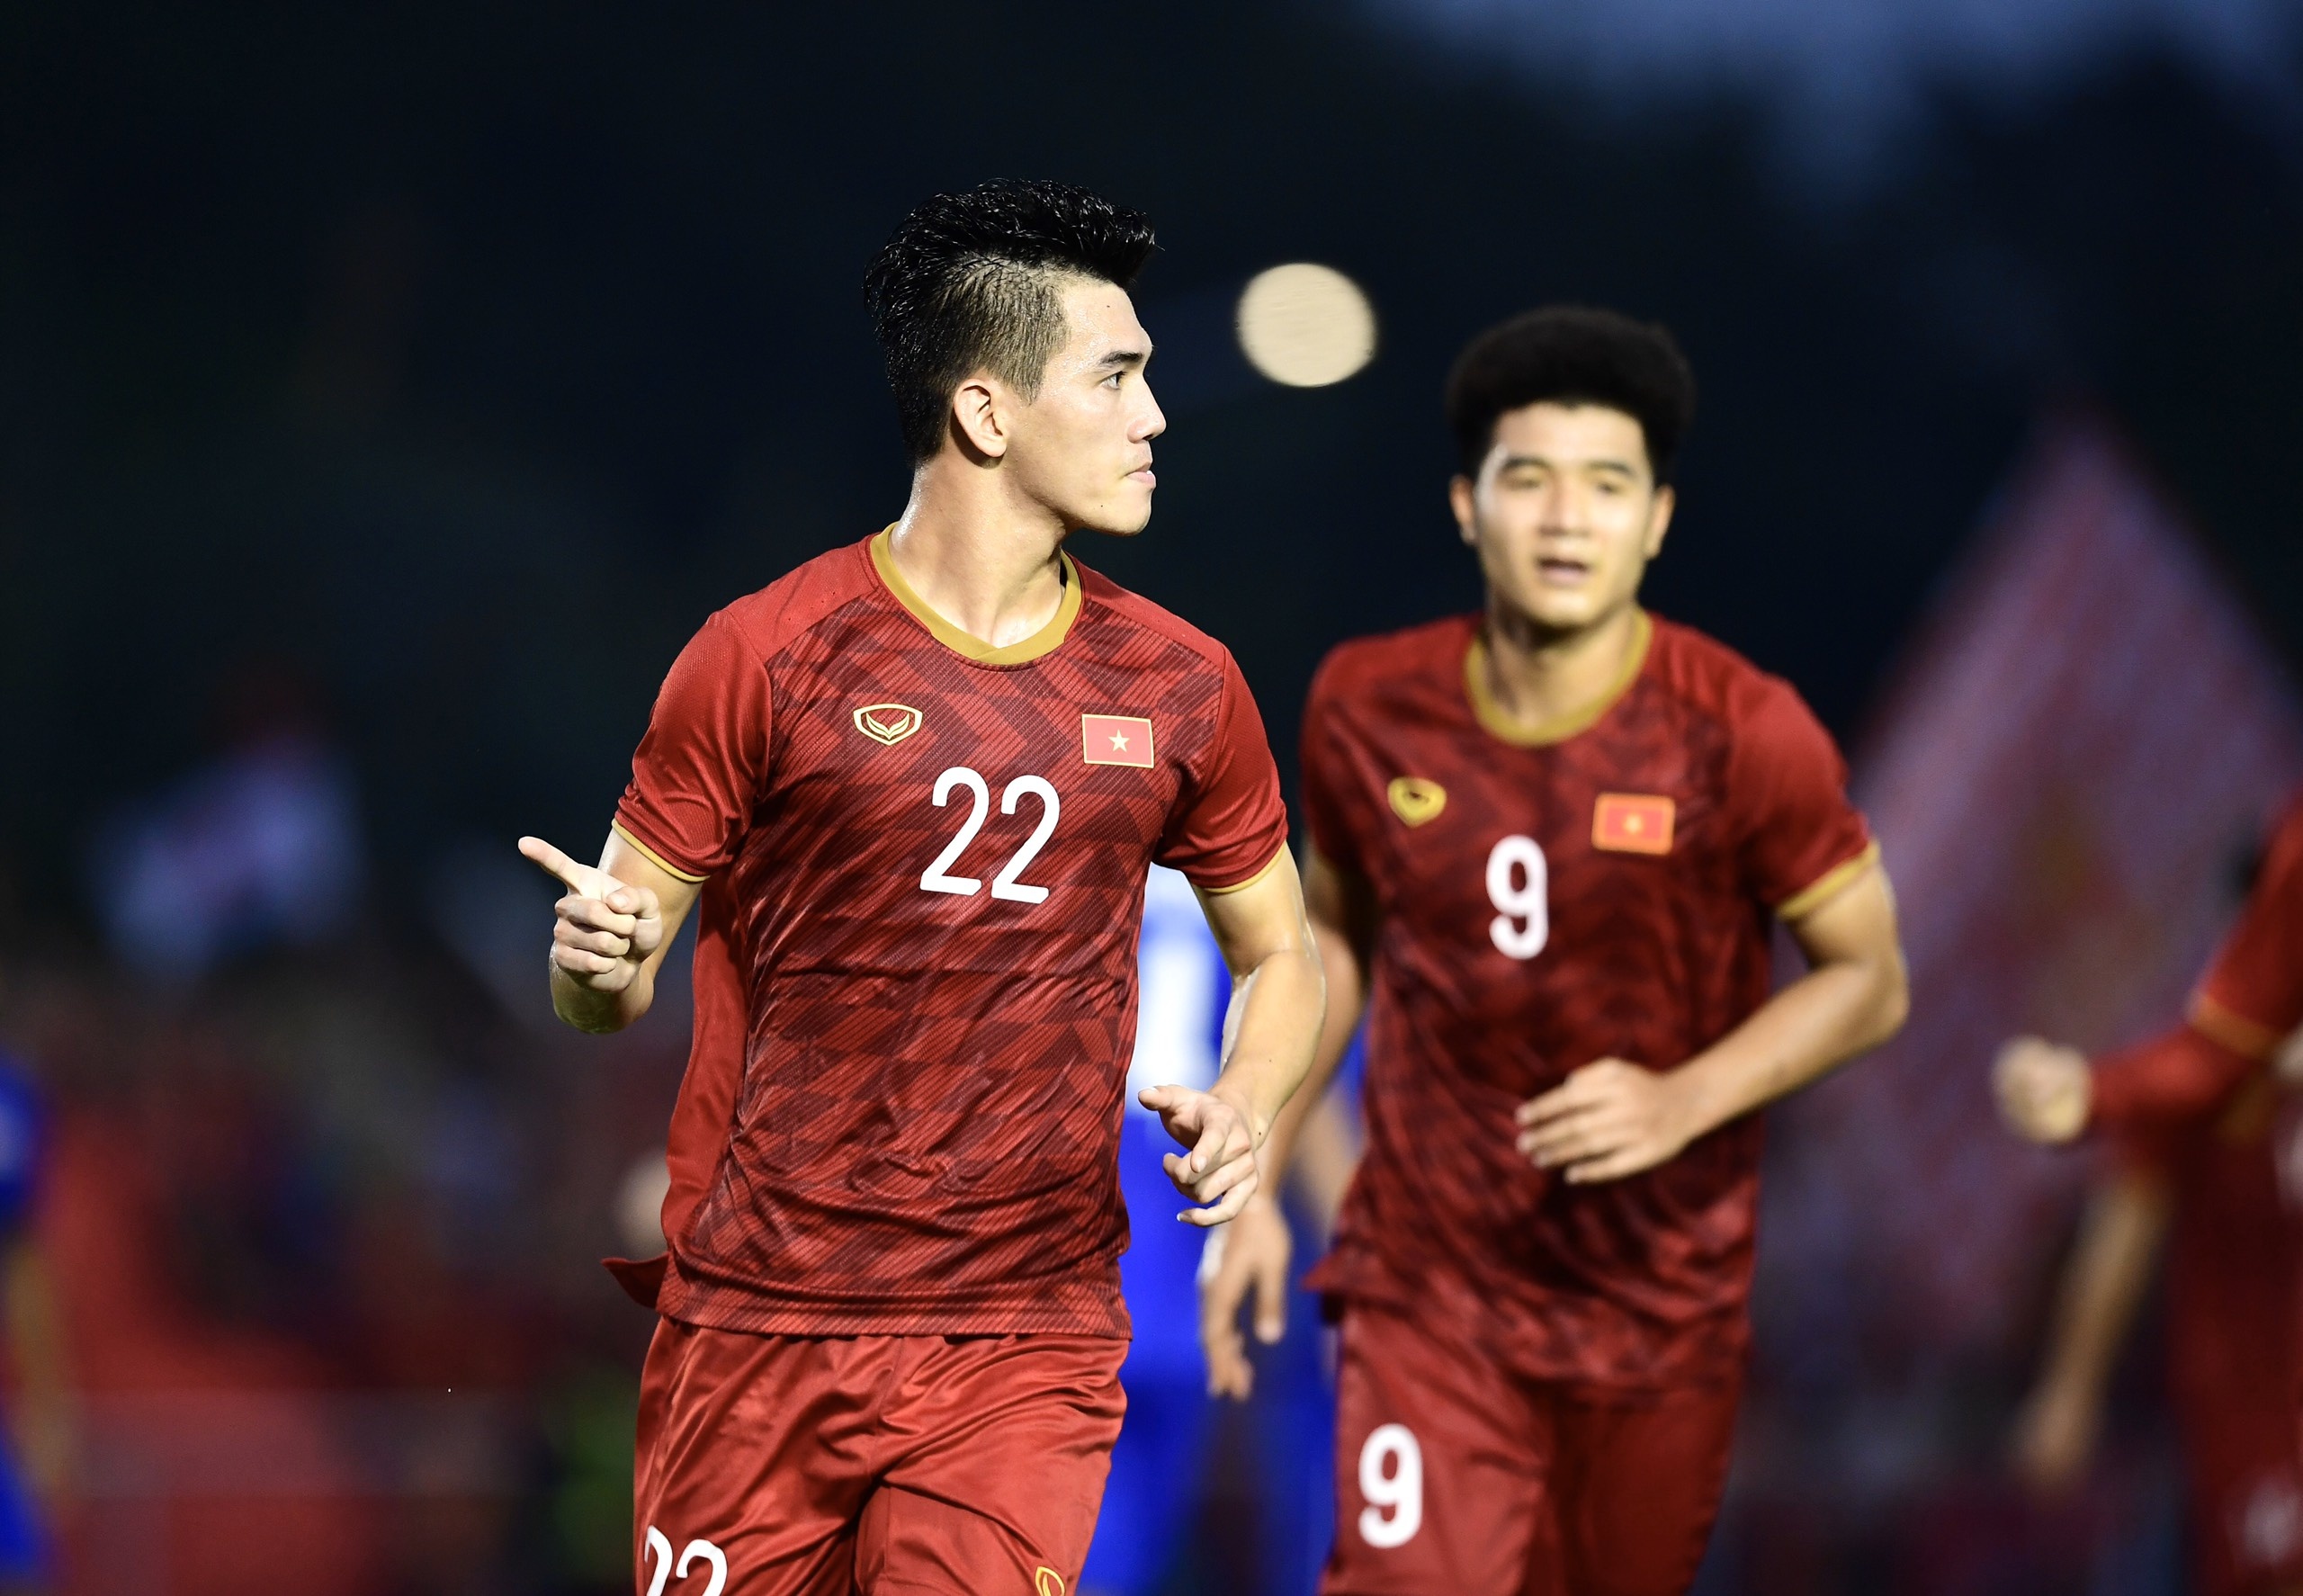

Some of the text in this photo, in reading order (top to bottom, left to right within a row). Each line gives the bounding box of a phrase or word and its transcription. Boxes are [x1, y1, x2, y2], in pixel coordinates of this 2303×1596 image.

[919, 766, 1061, 904] 22
[1485, 834, 1549, 960] 9
[1358, 1422, 1423, 1549] 9
